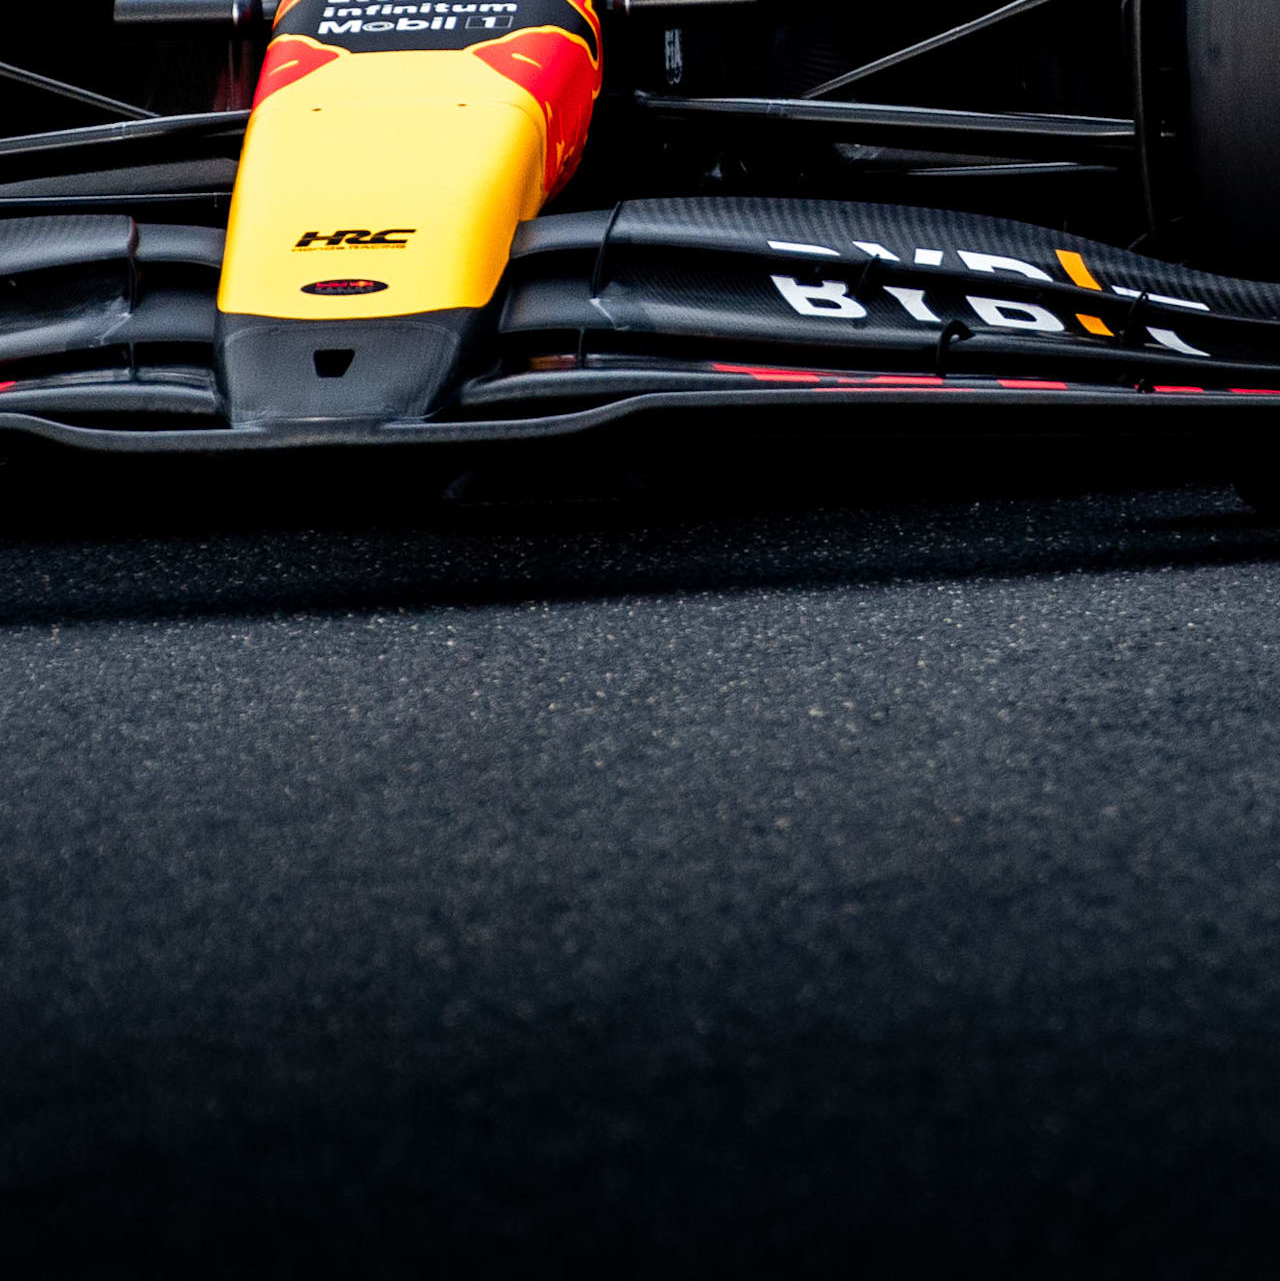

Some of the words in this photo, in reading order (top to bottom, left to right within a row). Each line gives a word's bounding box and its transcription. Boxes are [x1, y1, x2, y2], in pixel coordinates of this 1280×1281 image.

[322, 3, 518, 18] infinitum
[317, 16, 458, 35] Mobil
[294, 229, 417, 247] HRC
